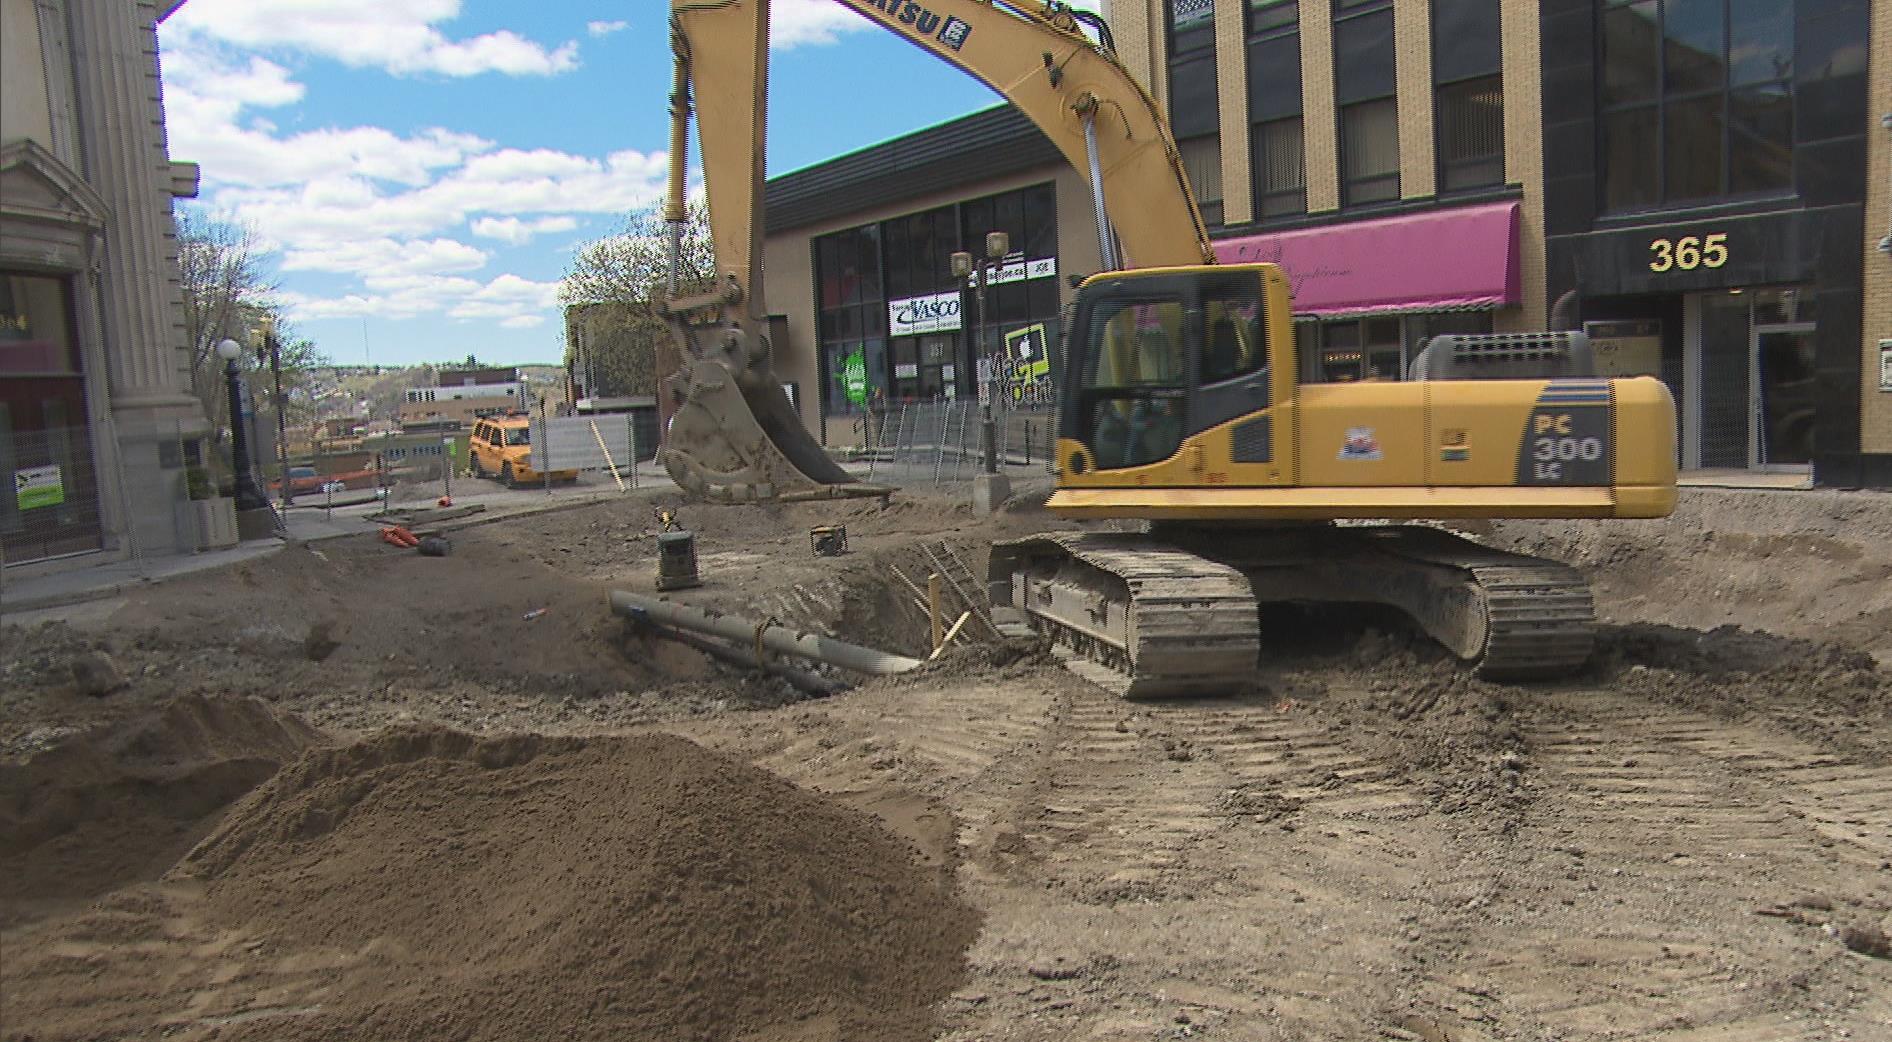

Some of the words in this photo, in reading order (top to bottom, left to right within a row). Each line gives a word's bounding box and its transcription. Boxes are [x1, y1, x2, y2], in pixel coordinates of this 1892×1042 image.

[1649, 232, 1728, 272] 365
[911, 300, 960, 319] VASCO
[988, 352, 1027, 380] Mac
[1534, 414, 1572, 434] PC
[1533, 437, 1602, 460] 300
[1534, 463, 1562, 479] LC
